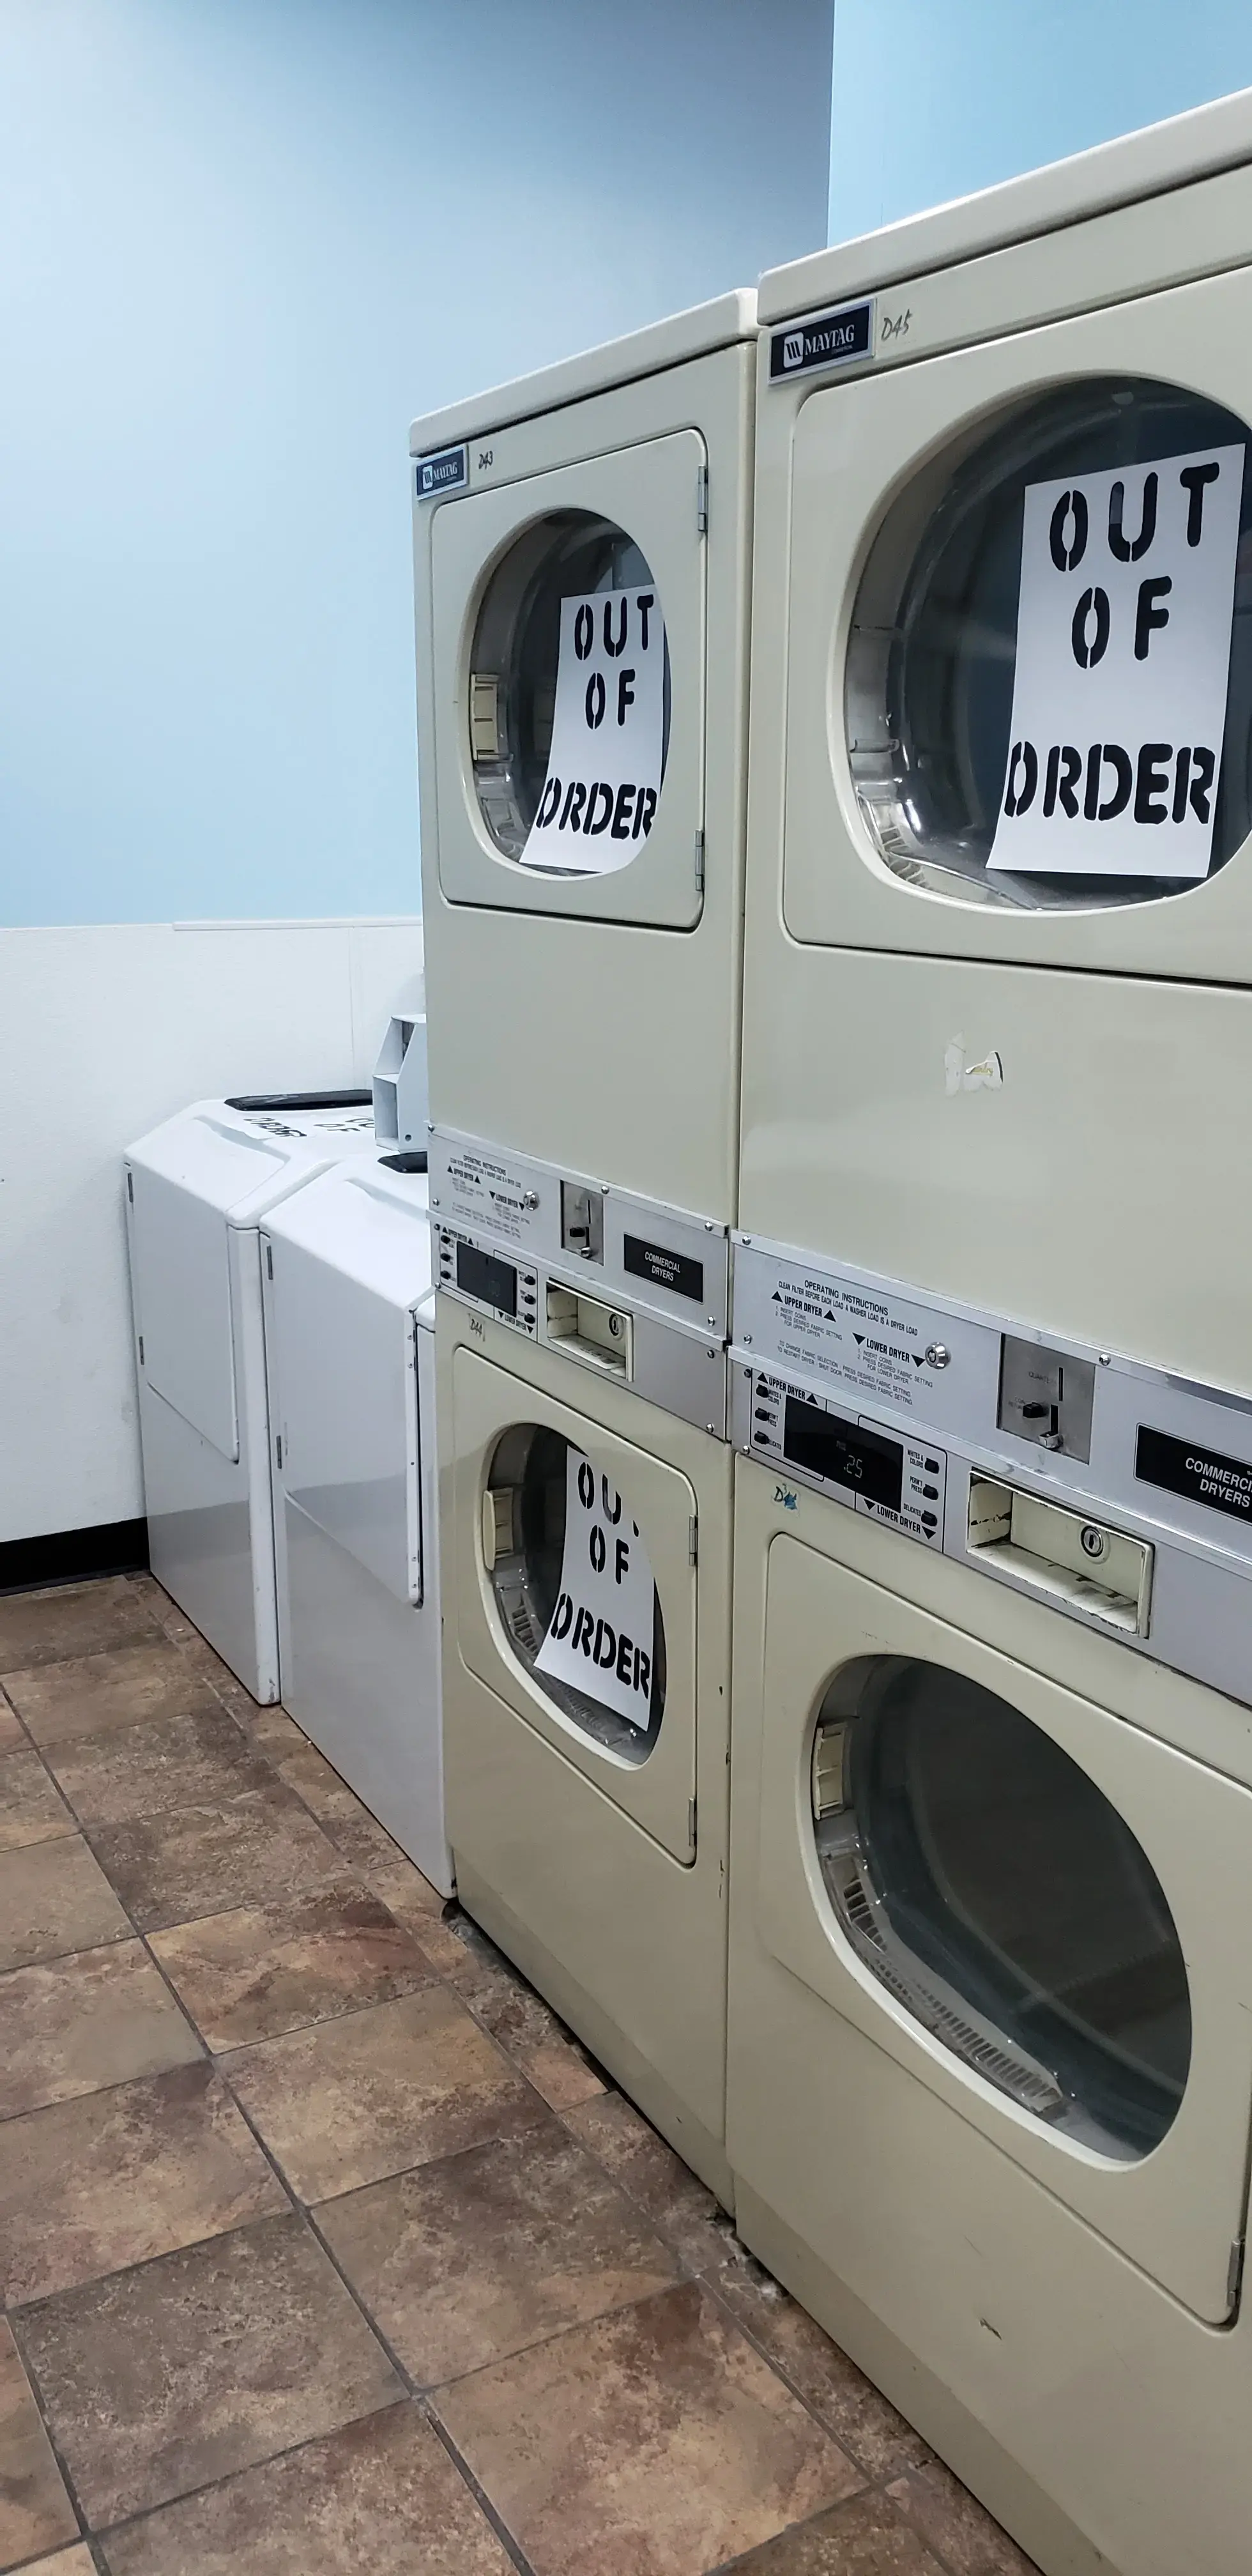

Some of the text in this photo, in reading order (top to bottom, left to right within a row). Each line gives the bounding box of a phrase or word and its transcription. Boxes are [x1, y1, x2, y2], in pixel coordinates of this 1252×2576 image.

[805, 325, 855, 356] MAYTAG
[881, 309, 913, 342] D45
[433, 462, 457, 481] MAYTAG
[1050, 462, 1219, 572] OUT
[574, 595, 654, 660] OUT
[1071, 576, 1172, 670] OF
[585, 669, 636, 730] OF
[1004, 741, 1216, 825] ORDER
[535, 777, 655, 840] ORDER
[645, 1252, 681, 1273] COMMERCIAL
[652, 1265, 674, 1282] DRYERS
[779, 1281, 791, 1291] CLEAN
[792, 1285, 804, 1296] FILTER
[805, 1290, 820, 1301] BEFORE
[821, 1296, 832, 1305] EACH
[833, 1300, 844, 1310] LOAD
[850, 1306, 866, 1317] WASHER
[867, 1312, 879, 1322] LOAD
[885, 1318, 889, 1326] A
[890, 1321, 905, 1331] DRYER
[906, 1326, 918, 1336] LOAD
[784, 1295, 822, 1317] UPPER DRYER
[804, 1280, 889, 1316] OPERATING INSTRUCTIONS
[866, 1338, 910, 1363] LOWER DRYER
[768, 1376, 805, 1400] UPPER DRYER
[878, 1368, 892, 1378] LOWER
[897, 1369, 913, 1380] FABRIC
[914, 1376, 933, 1388] SETTING
[907, 1449, 920, 1460] WHITES
[910, 1457, 924, 1469] COLORS
[911, 1483, 922, 1494] PRESS
[1186, 1457, 1252, 1493] COMMERCI
[577, 1461, 639, 1538] OU
[1200, 1478, 1250, 1508] DRYERS
[877, 1505, 920, 1534] LOWER DRYER
[903, 1503, 921, 1516] DELICATES
[589, 1524, 629, 1584] OF
[549, 1592, 650, 1699] ORDER
